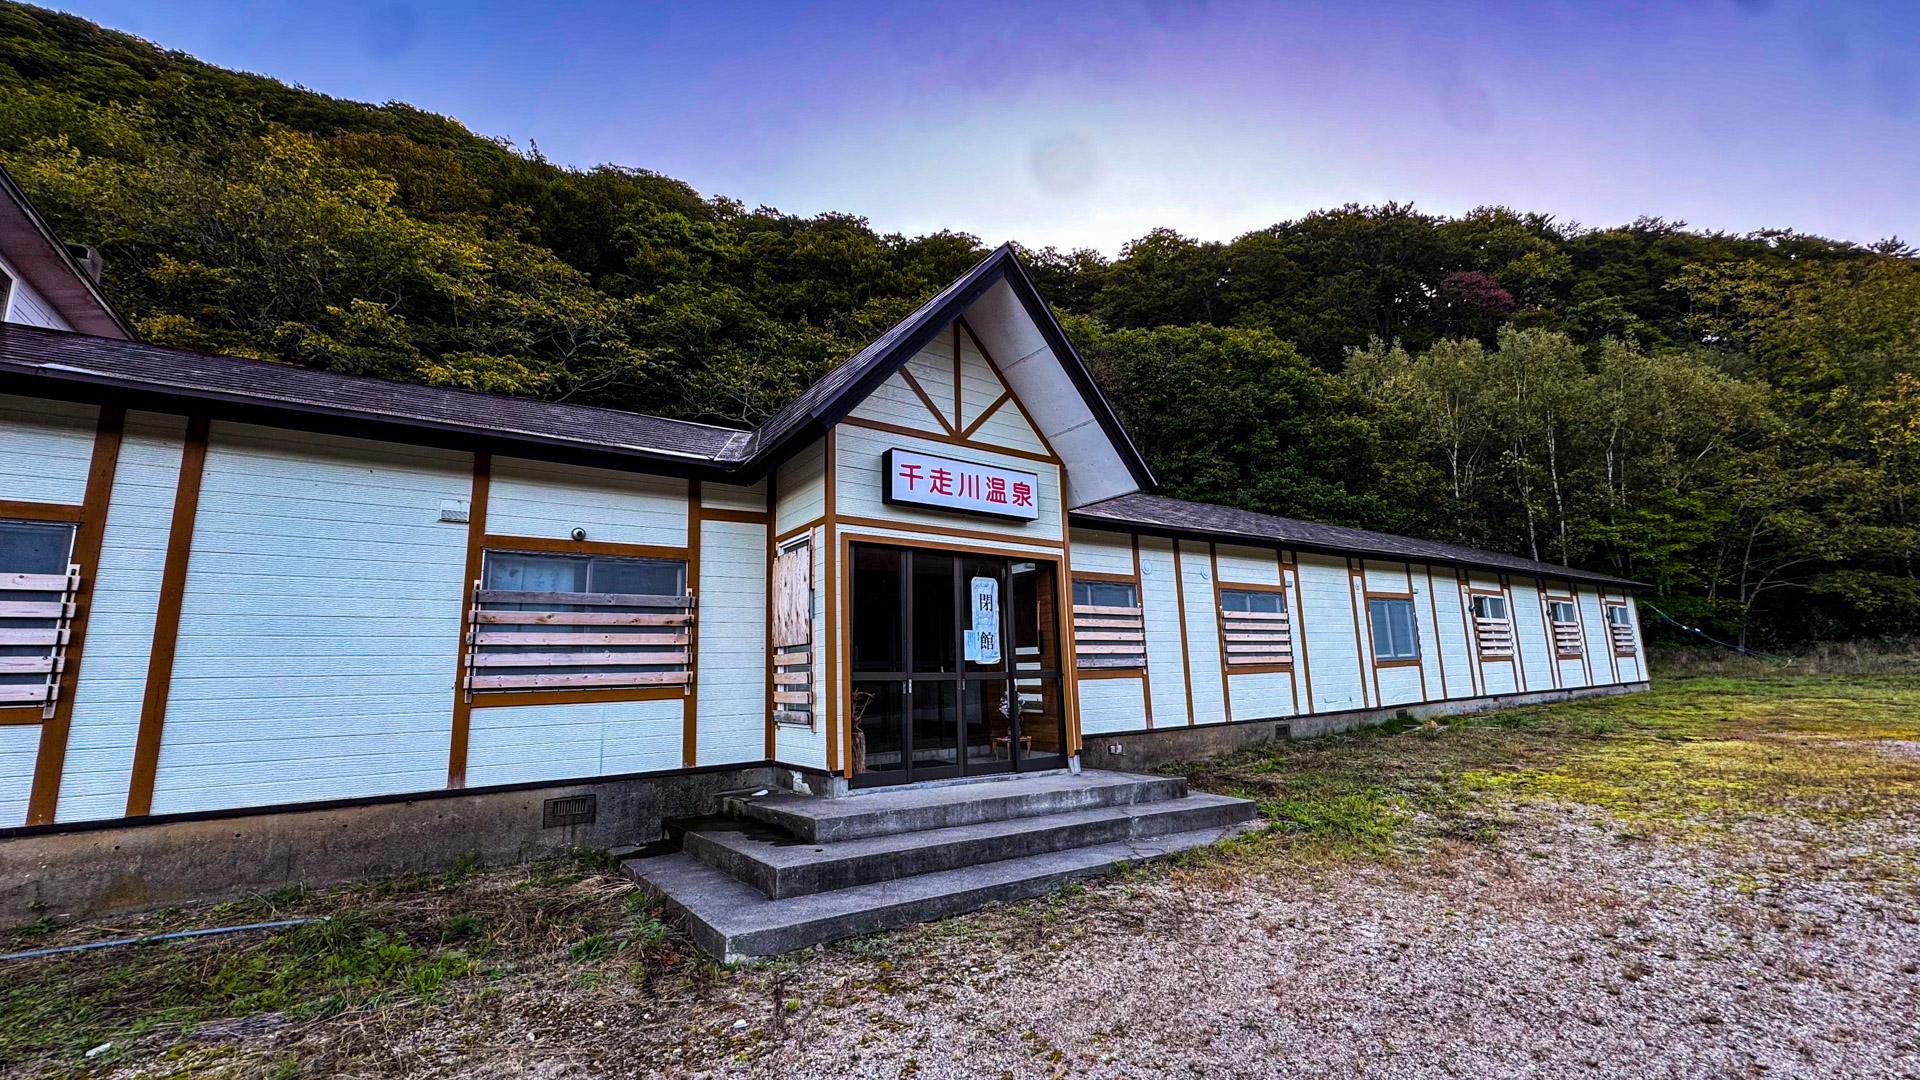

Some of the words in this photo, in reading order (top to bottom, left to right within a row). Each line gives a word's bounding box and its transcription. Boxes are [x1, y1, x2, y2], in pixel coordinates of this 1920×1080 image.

[899, 463, 1033, 507] 千走川温泉
[979, 593, 994, 650] 閉館
